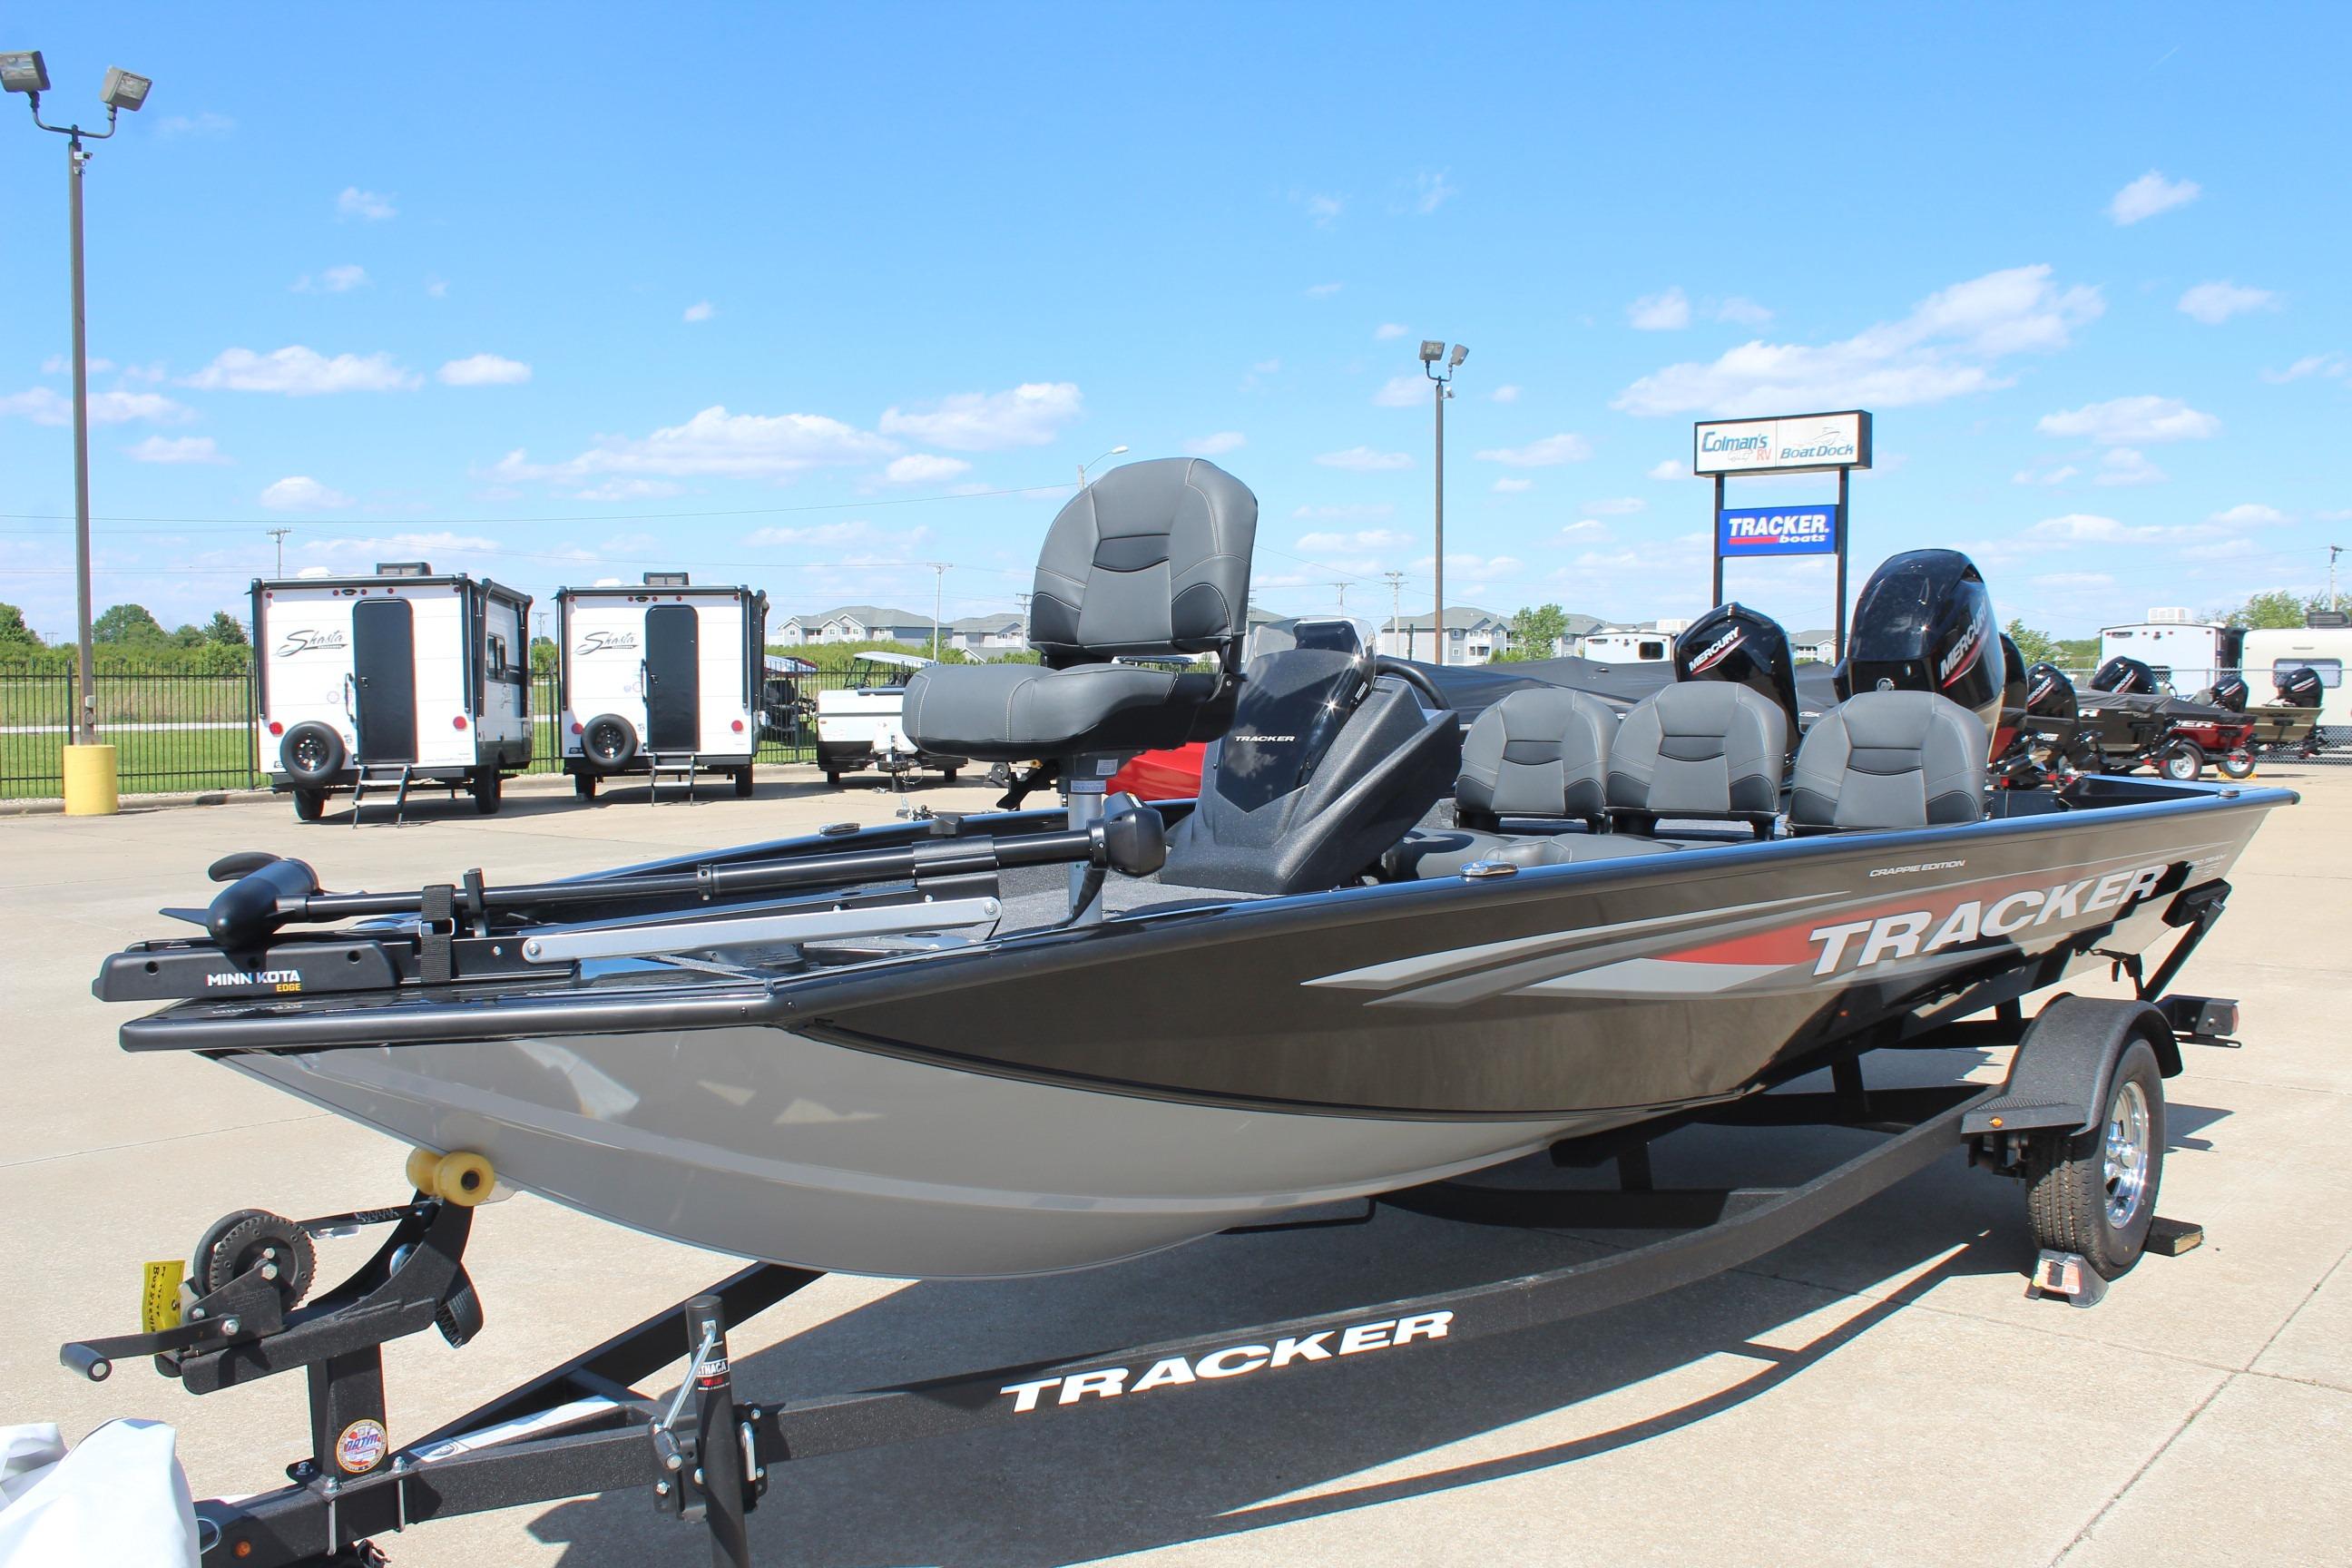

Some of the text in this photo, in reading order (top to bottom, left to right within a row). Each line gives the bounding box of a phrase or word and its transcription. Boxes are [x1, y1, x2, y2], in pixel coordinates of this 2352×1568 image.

[1701, 432, 1769, 452] Colman's
[1757, 448, 1771, 461] RV
[1780, 445, 1854, 459] Boat Dock
[1779, 534, 1826, 544] boats
[273, 630, 344, 657] Shasta
[574, 632, 635, 655] Shasta
[1689, 626, 1740, 671] MERCURY
[1869, 859, 1965, 877] CRAPPIE EDITION
[1809, 864, 2169, 975] TRACKER
[207, 970, 300, 986] MINN KOTA
[276, 983, 301, 992] EDGE
[999, 1310, 1454, 1413] TRACKER
